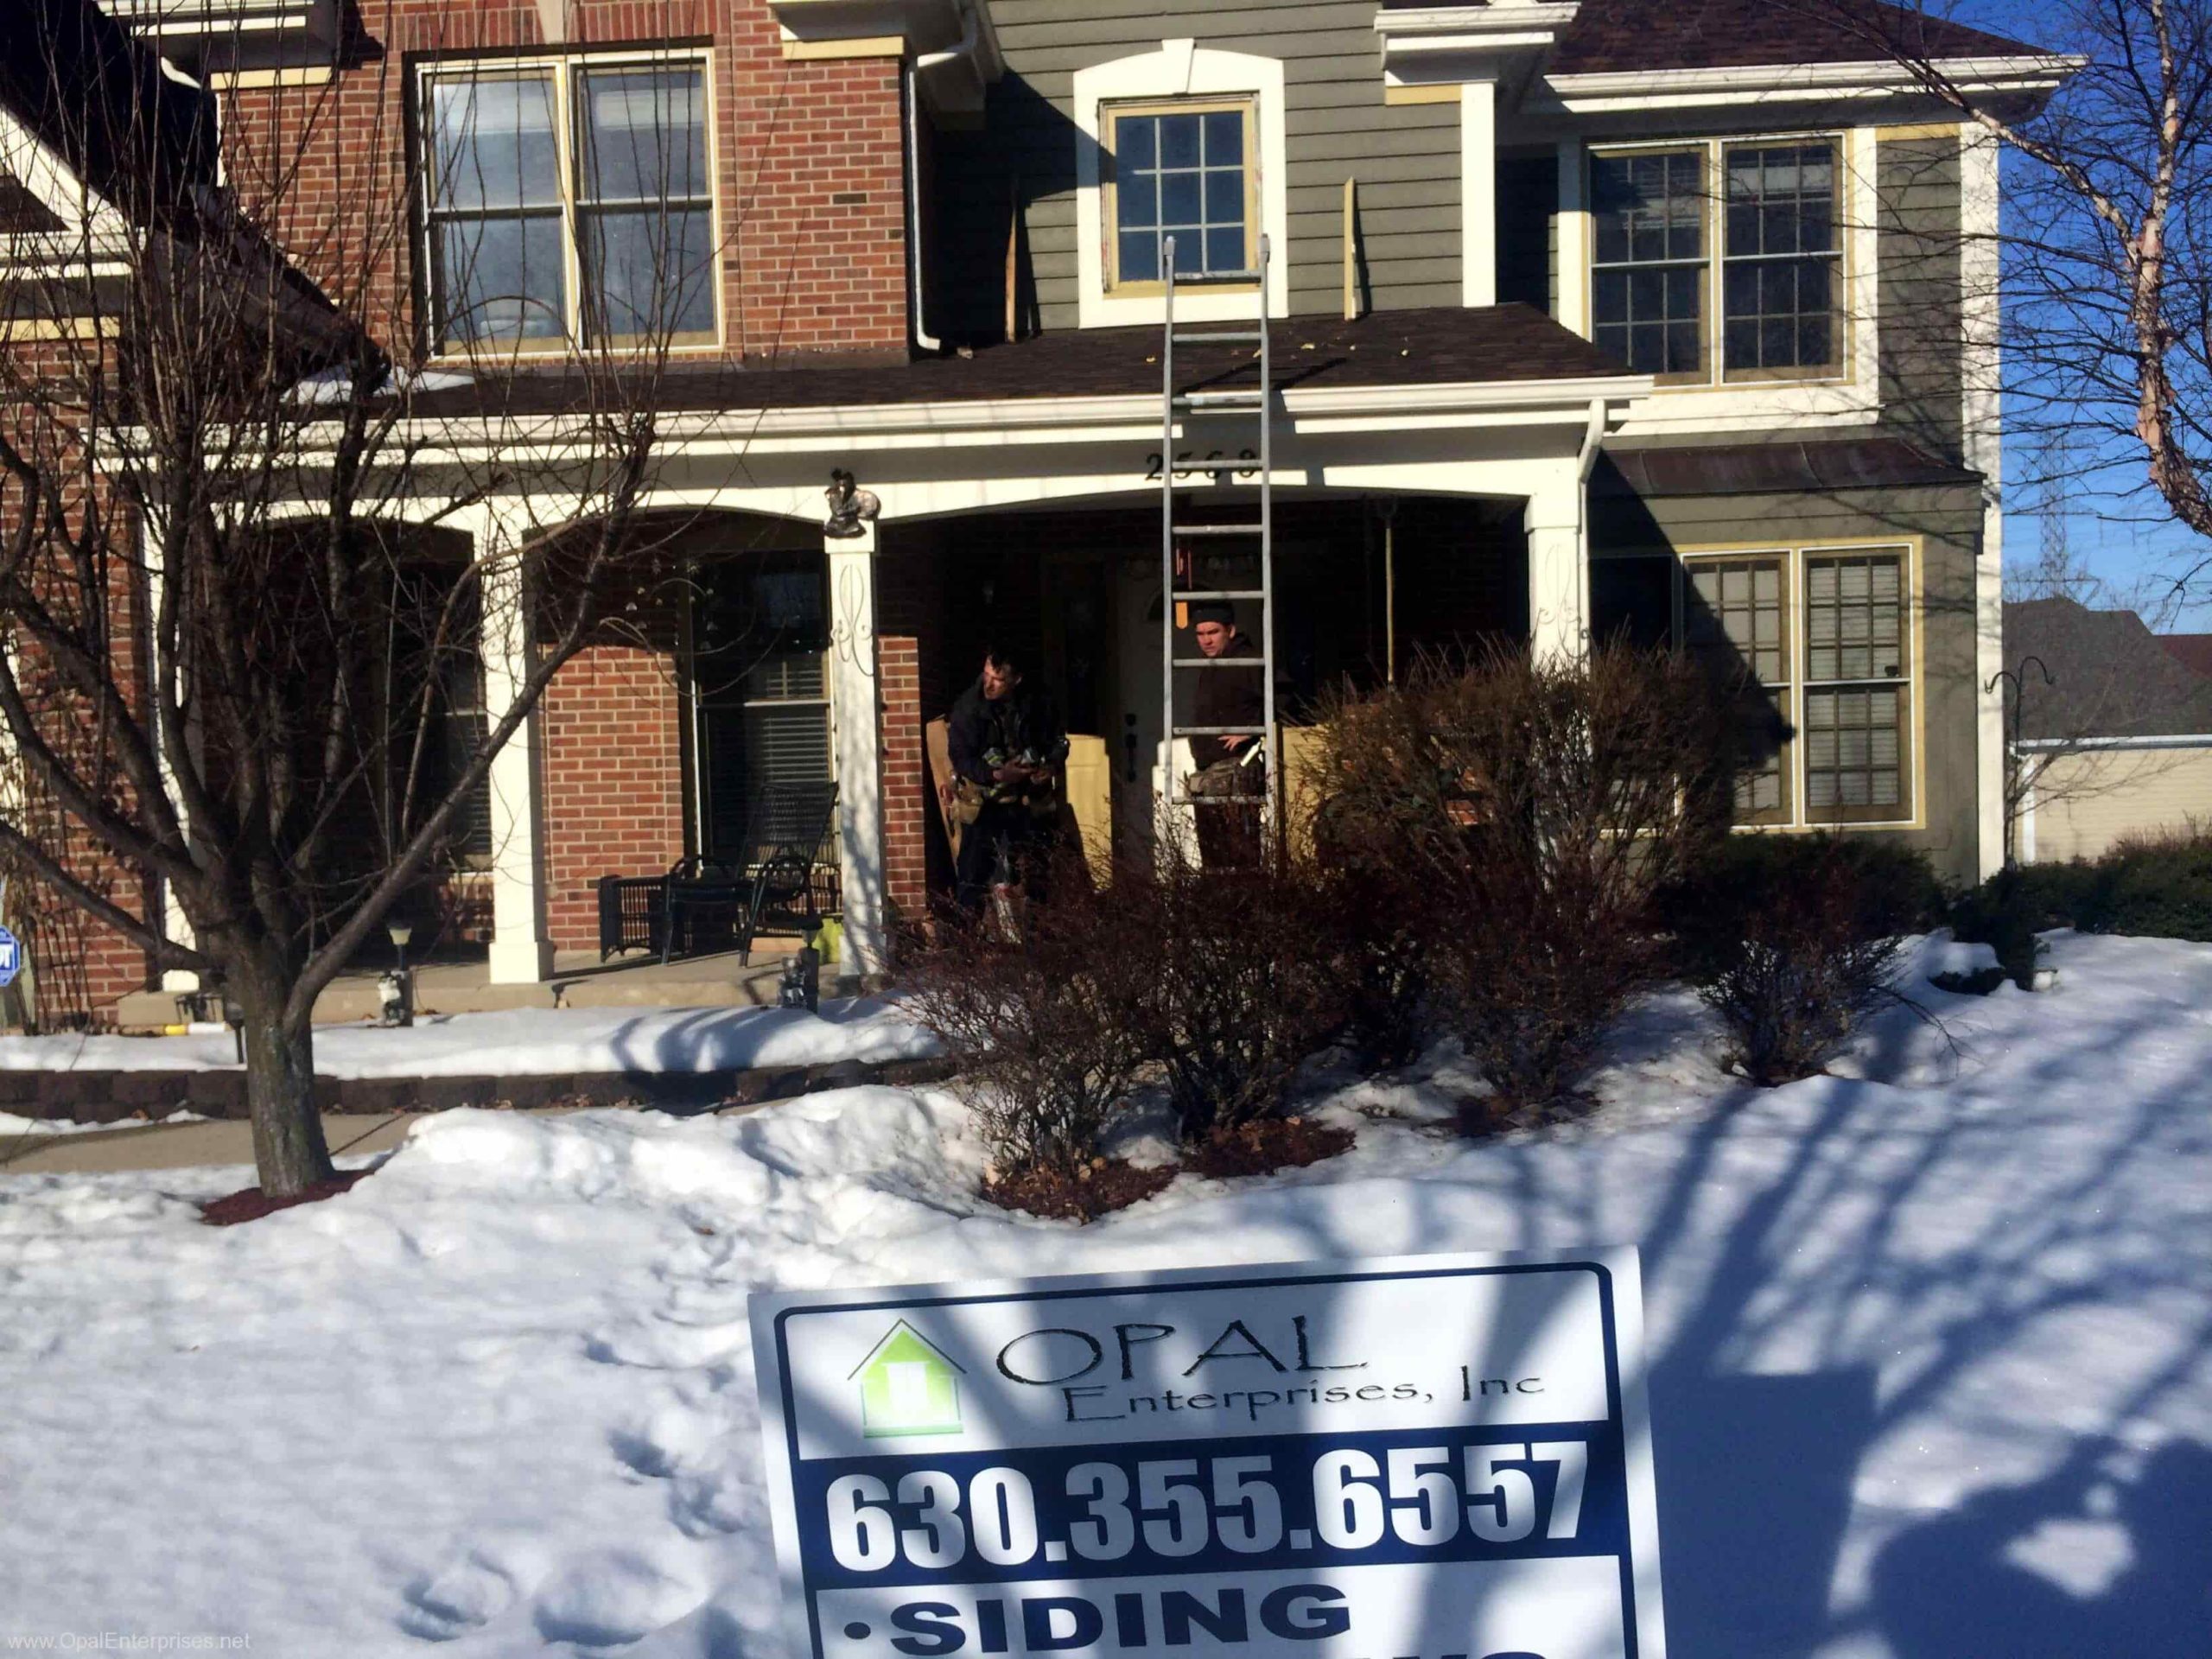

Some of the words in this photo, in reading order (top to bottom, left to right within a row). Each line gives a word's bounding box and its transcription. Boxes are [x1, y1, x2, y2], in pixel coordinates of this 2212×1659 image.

[995, 1314, 1369, 1385] OPAL
[1061, 1378, 1434, 1422] Enterprises,
[1460, 1365, 1545, 1402] Inc
[825, 1440, 1589, 1573] 630.355.6557
[890, 1583, 1351, 1656] SIDING
